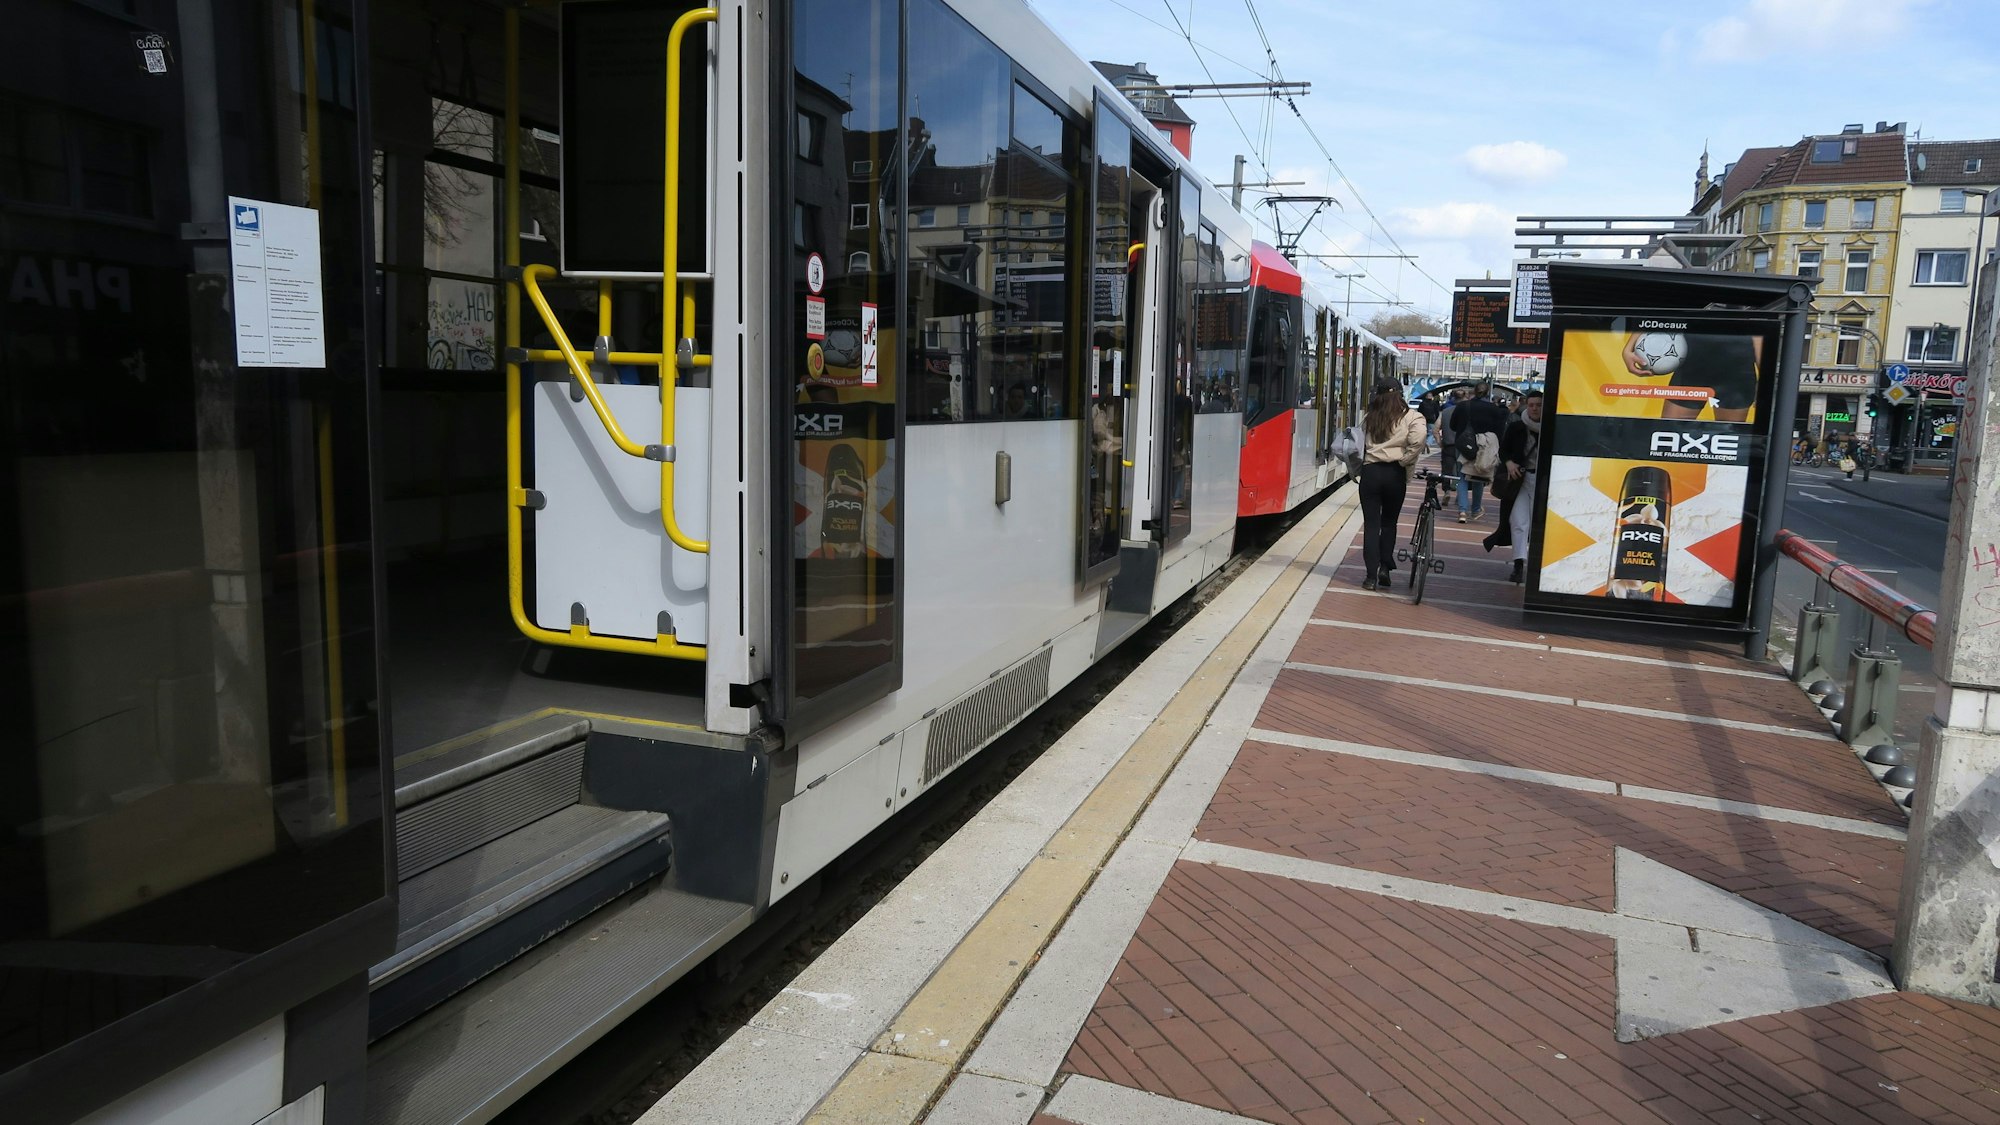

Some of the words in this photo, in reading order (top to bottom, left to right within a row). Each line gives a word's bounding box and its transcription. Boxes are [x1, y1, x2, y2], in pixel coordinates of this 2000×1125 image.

[1638, 320, 1687, 330] JCDecaux
[1827, 373, 1867, 384] KINGS
[1618, 387, 1640, 396] geht's
[1653, 387, 1708, 398] kununu.com
[1826, 412, 1850, 421] PIZZA
[1650, 431, 1739, 456] AXE
[1664, 451, 1699, 459] FRAGRANCE
[1699, 453, 1737, 461] COLLECTION
[1621, 530, 1662, 544] AXE
[1626, 550, 1653, 559] BLACK
[1622, 558, 1656, 566] VANILLA
